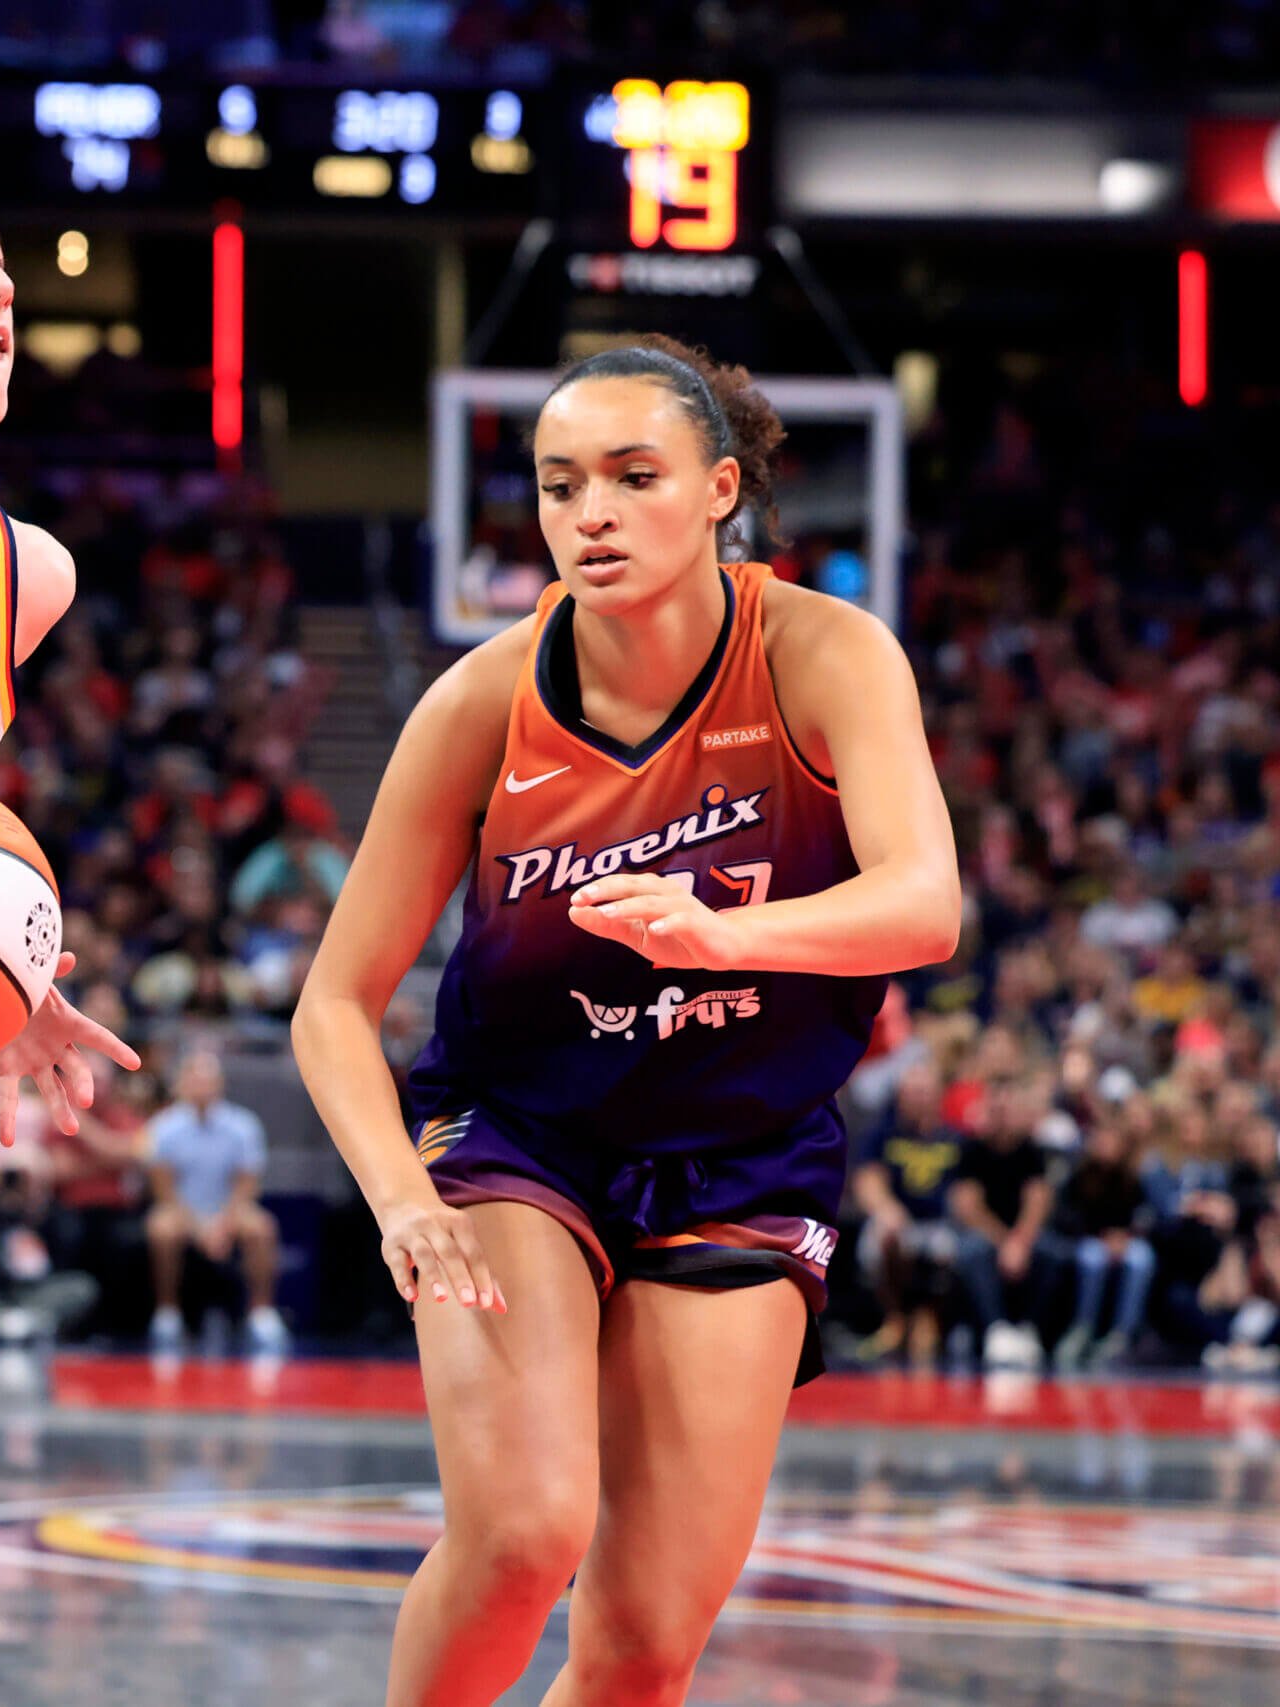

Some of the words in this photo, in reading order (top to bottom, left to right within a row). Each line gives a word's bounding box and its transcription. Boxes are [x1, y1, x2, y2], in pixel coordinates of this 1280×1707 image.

[629, 146, 737, 250] 19
[703, 726, 770, 748] PARTAKE
[498, 784, 766, 903] Phoenix
[645, 986, 761, 1040] fry's
